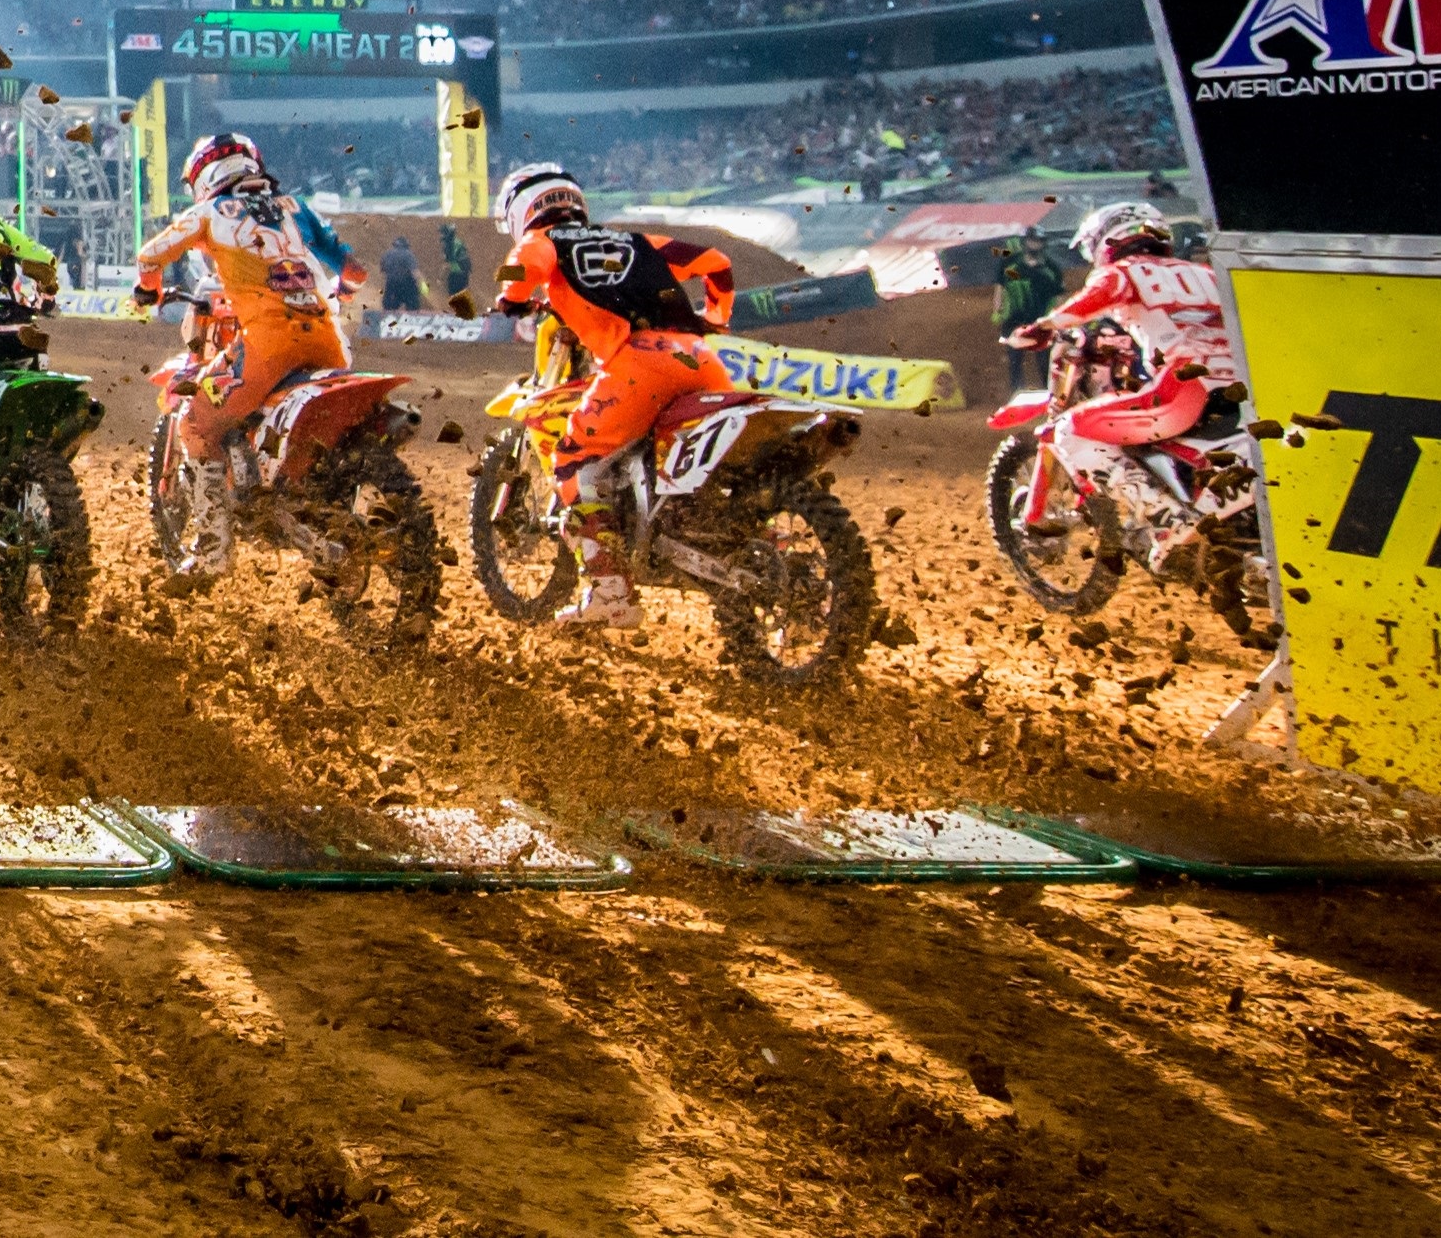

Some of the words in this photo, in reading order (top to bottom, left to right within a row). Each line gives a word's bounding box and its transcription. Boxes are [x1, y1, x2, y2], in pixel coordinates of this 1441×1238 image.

[171, 29, 302, 60] 450SX
[310, 33, 390, 60] HEAT
[1196, 75, 1335, 102] AMERICAN
[717, 348, 898, 401] SUZUKI
